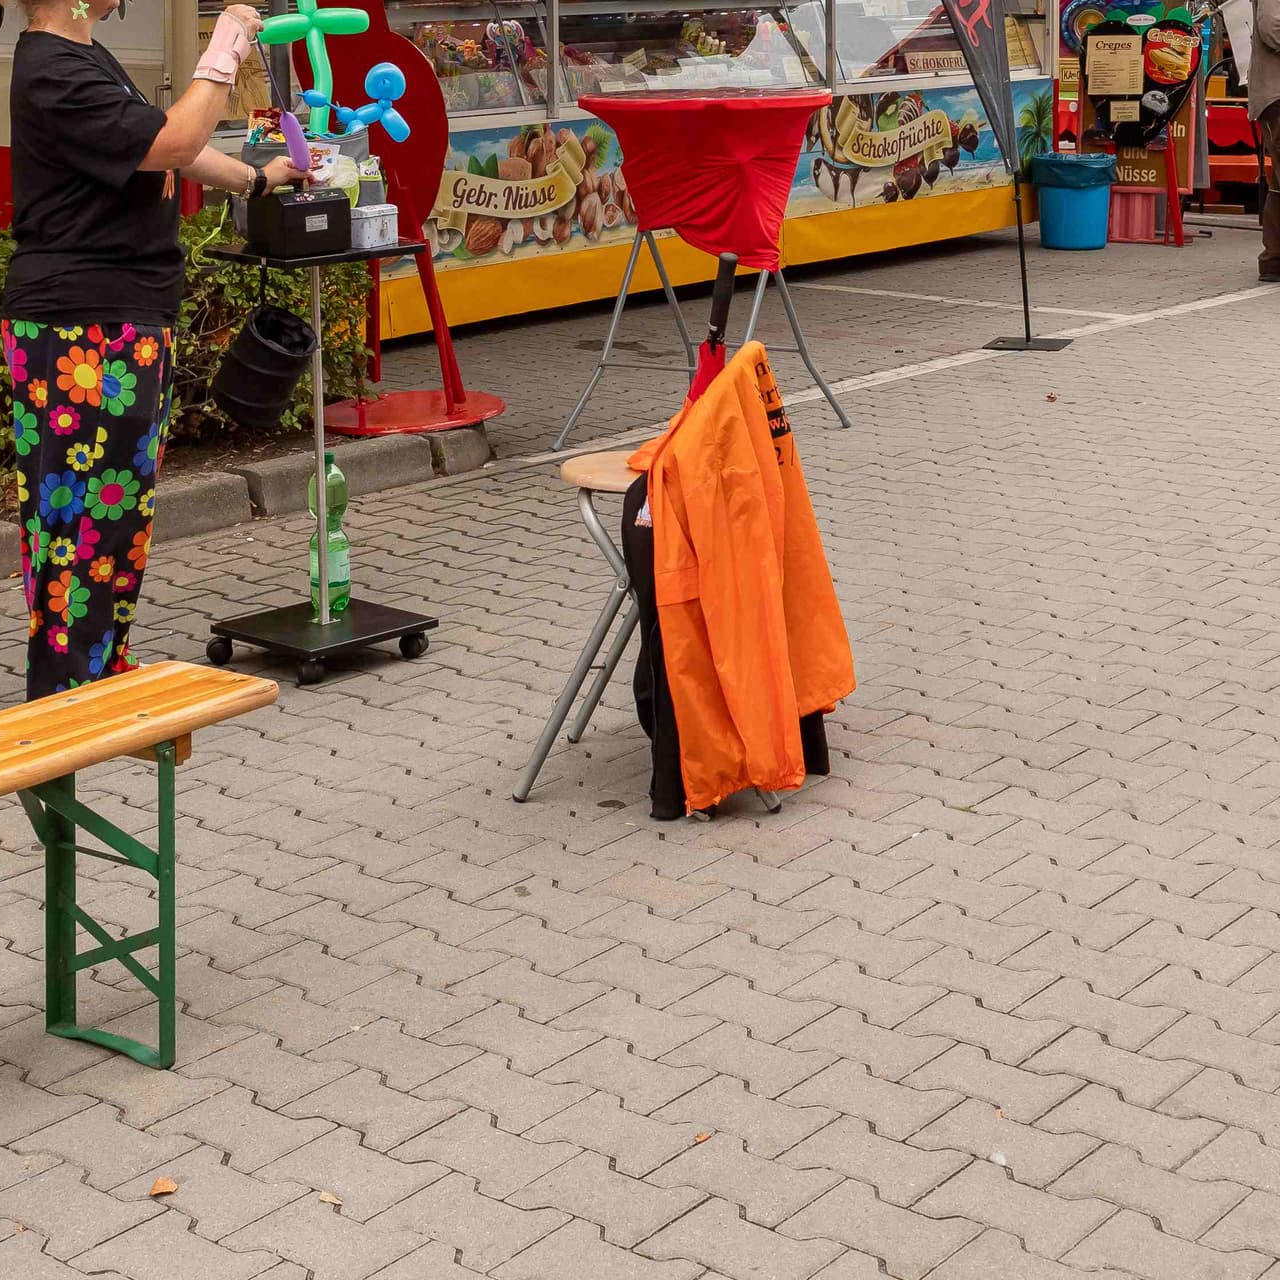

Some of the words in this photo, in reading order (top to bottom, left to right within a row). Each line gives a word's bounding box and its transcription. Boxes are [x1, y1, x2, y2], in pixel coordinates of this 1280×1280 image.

[851, 118, 943, 162] Schokofrüchte
[1116, 165, 1157, 182] Nüsse
[452, 177, 498, 209] Gebr.
[503, 184, 558, 211] Nüsse
